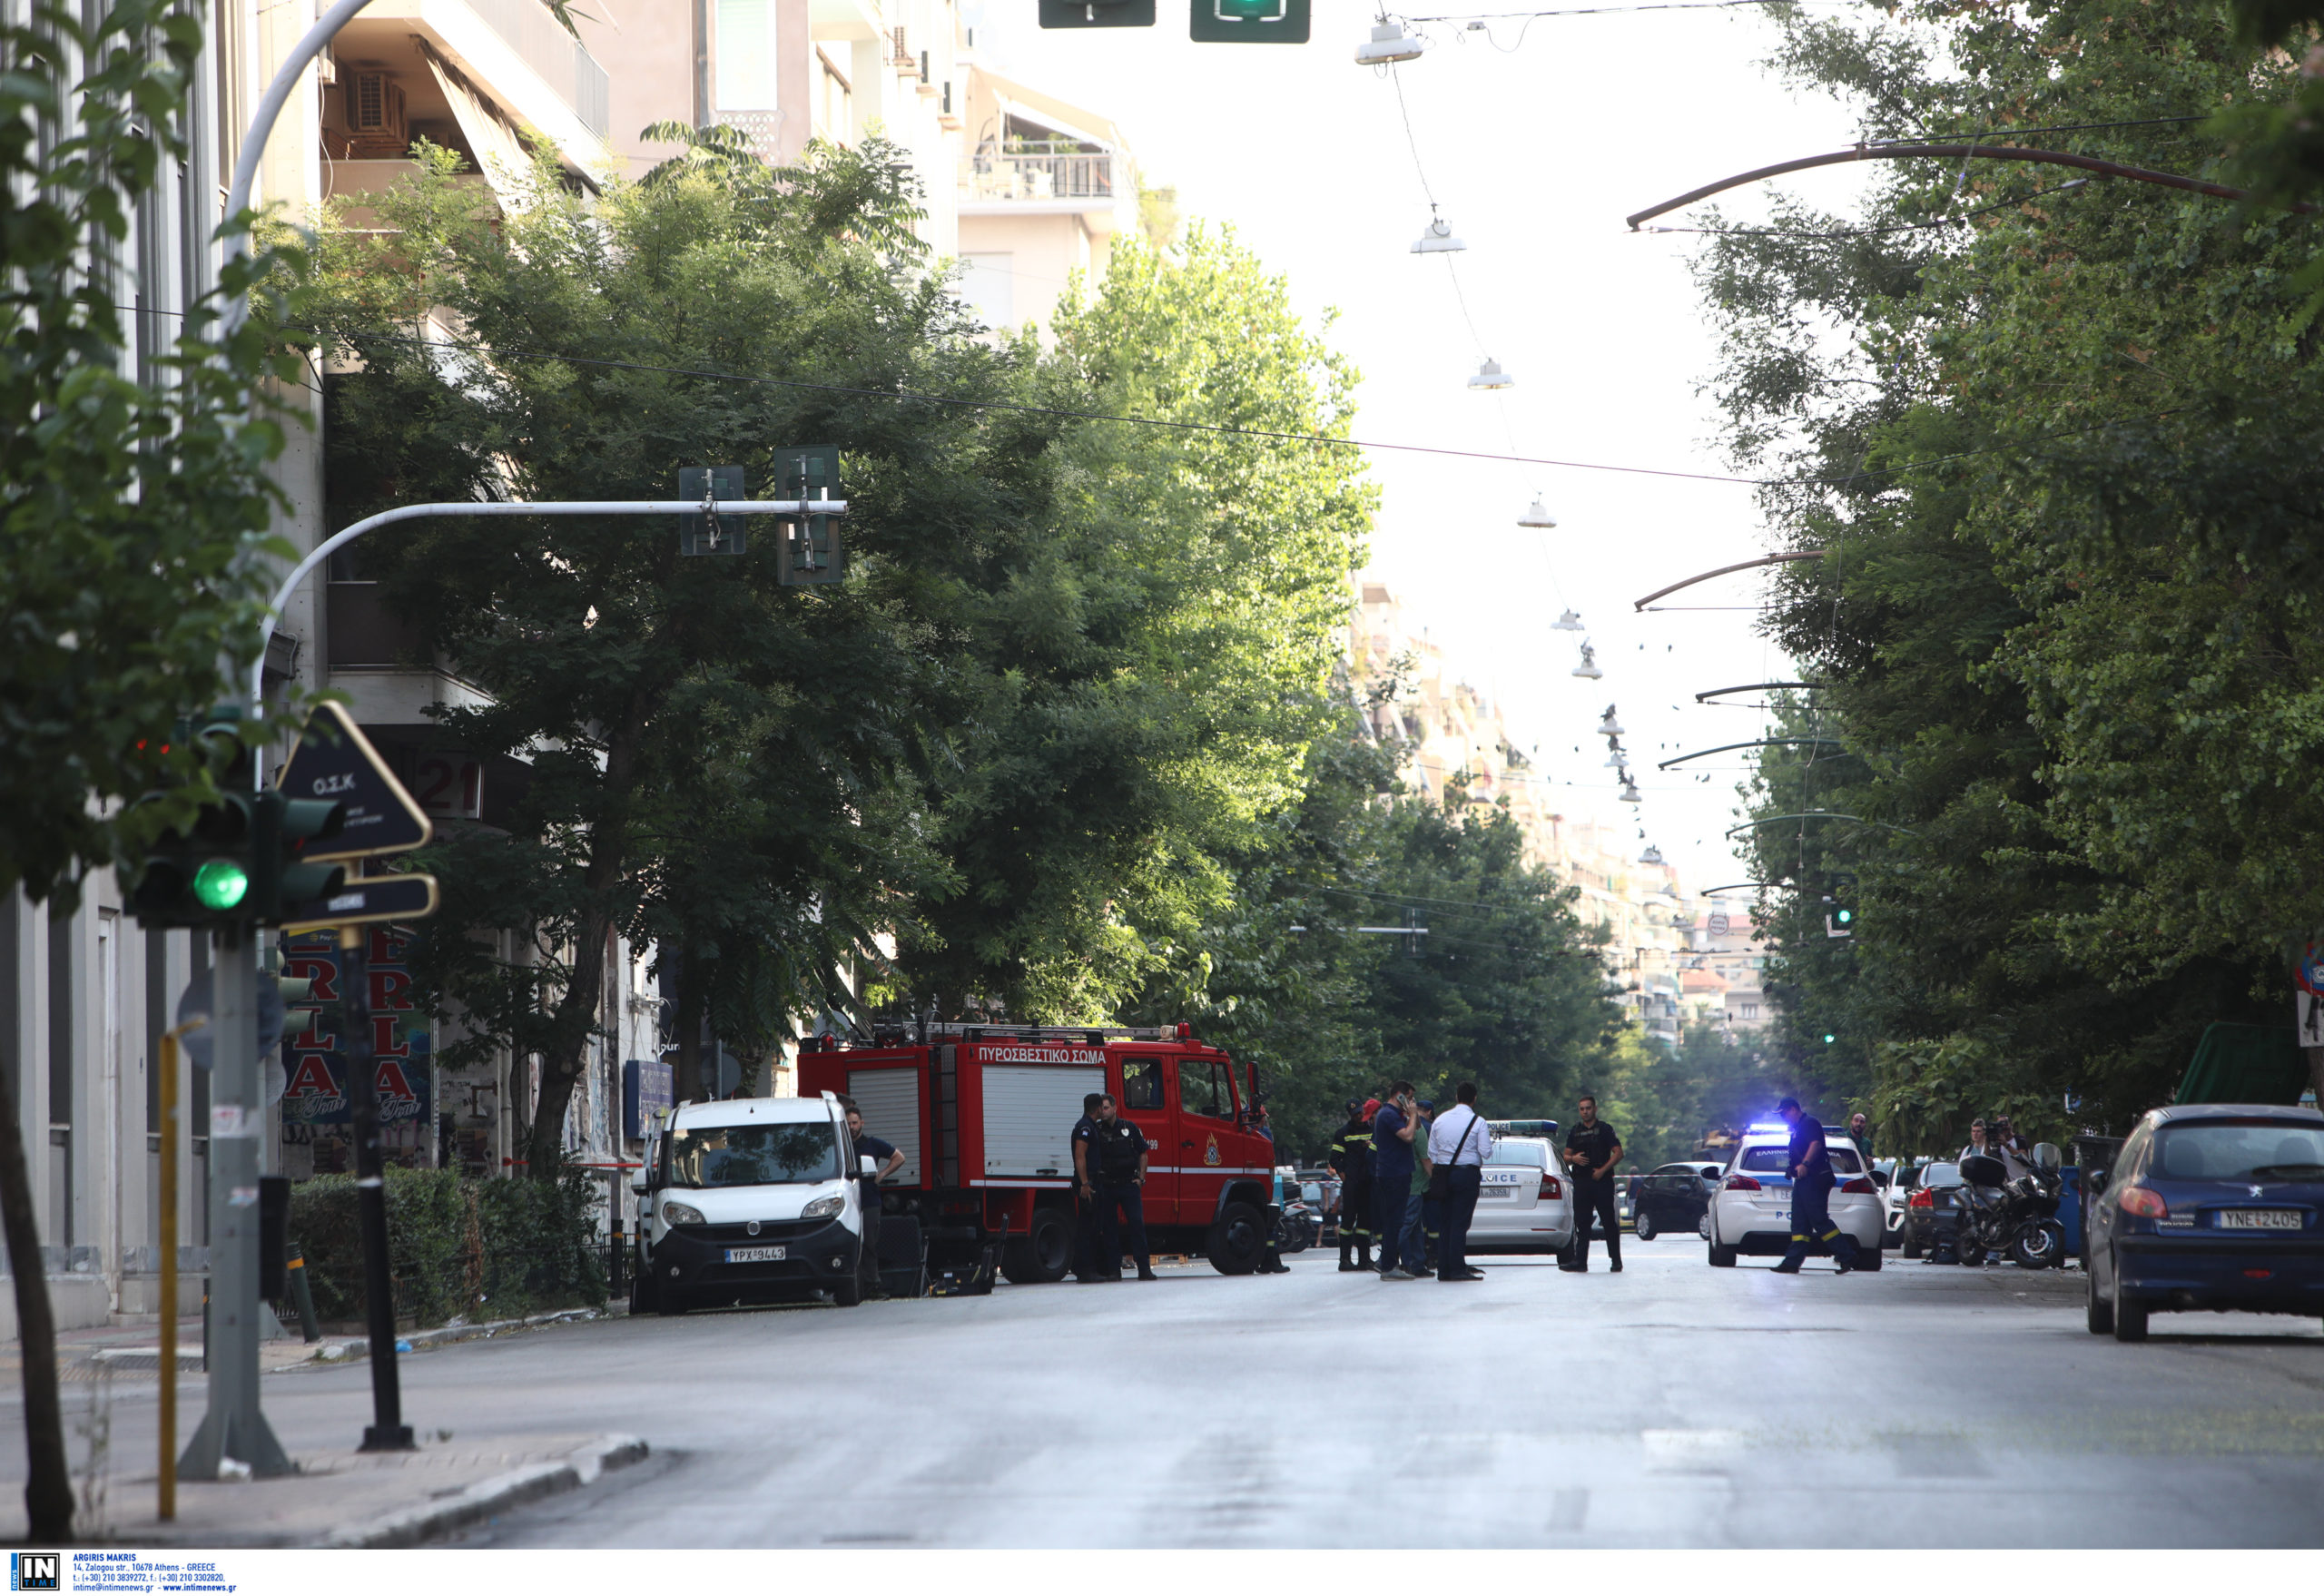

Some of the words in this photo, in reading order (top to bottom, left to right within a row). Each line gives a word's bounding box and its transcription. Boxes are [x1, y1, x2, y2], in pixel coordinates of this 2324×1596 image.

[418, 759, 476, 811] 21
[979, 1047, 1069, 1063] ΠΥΡΟΣΒΕΣΤΙΚΟ
[1071, 1049, 1107, 1064] ΣΩΜΑ
[1487, 1122, 1511, 1131] POLICE
[1481, 1174, 1518, 1183] LICE
[2227, 1212, 2255, 1227] YNE
[2262, 1213, 2299, 1227] 2405
